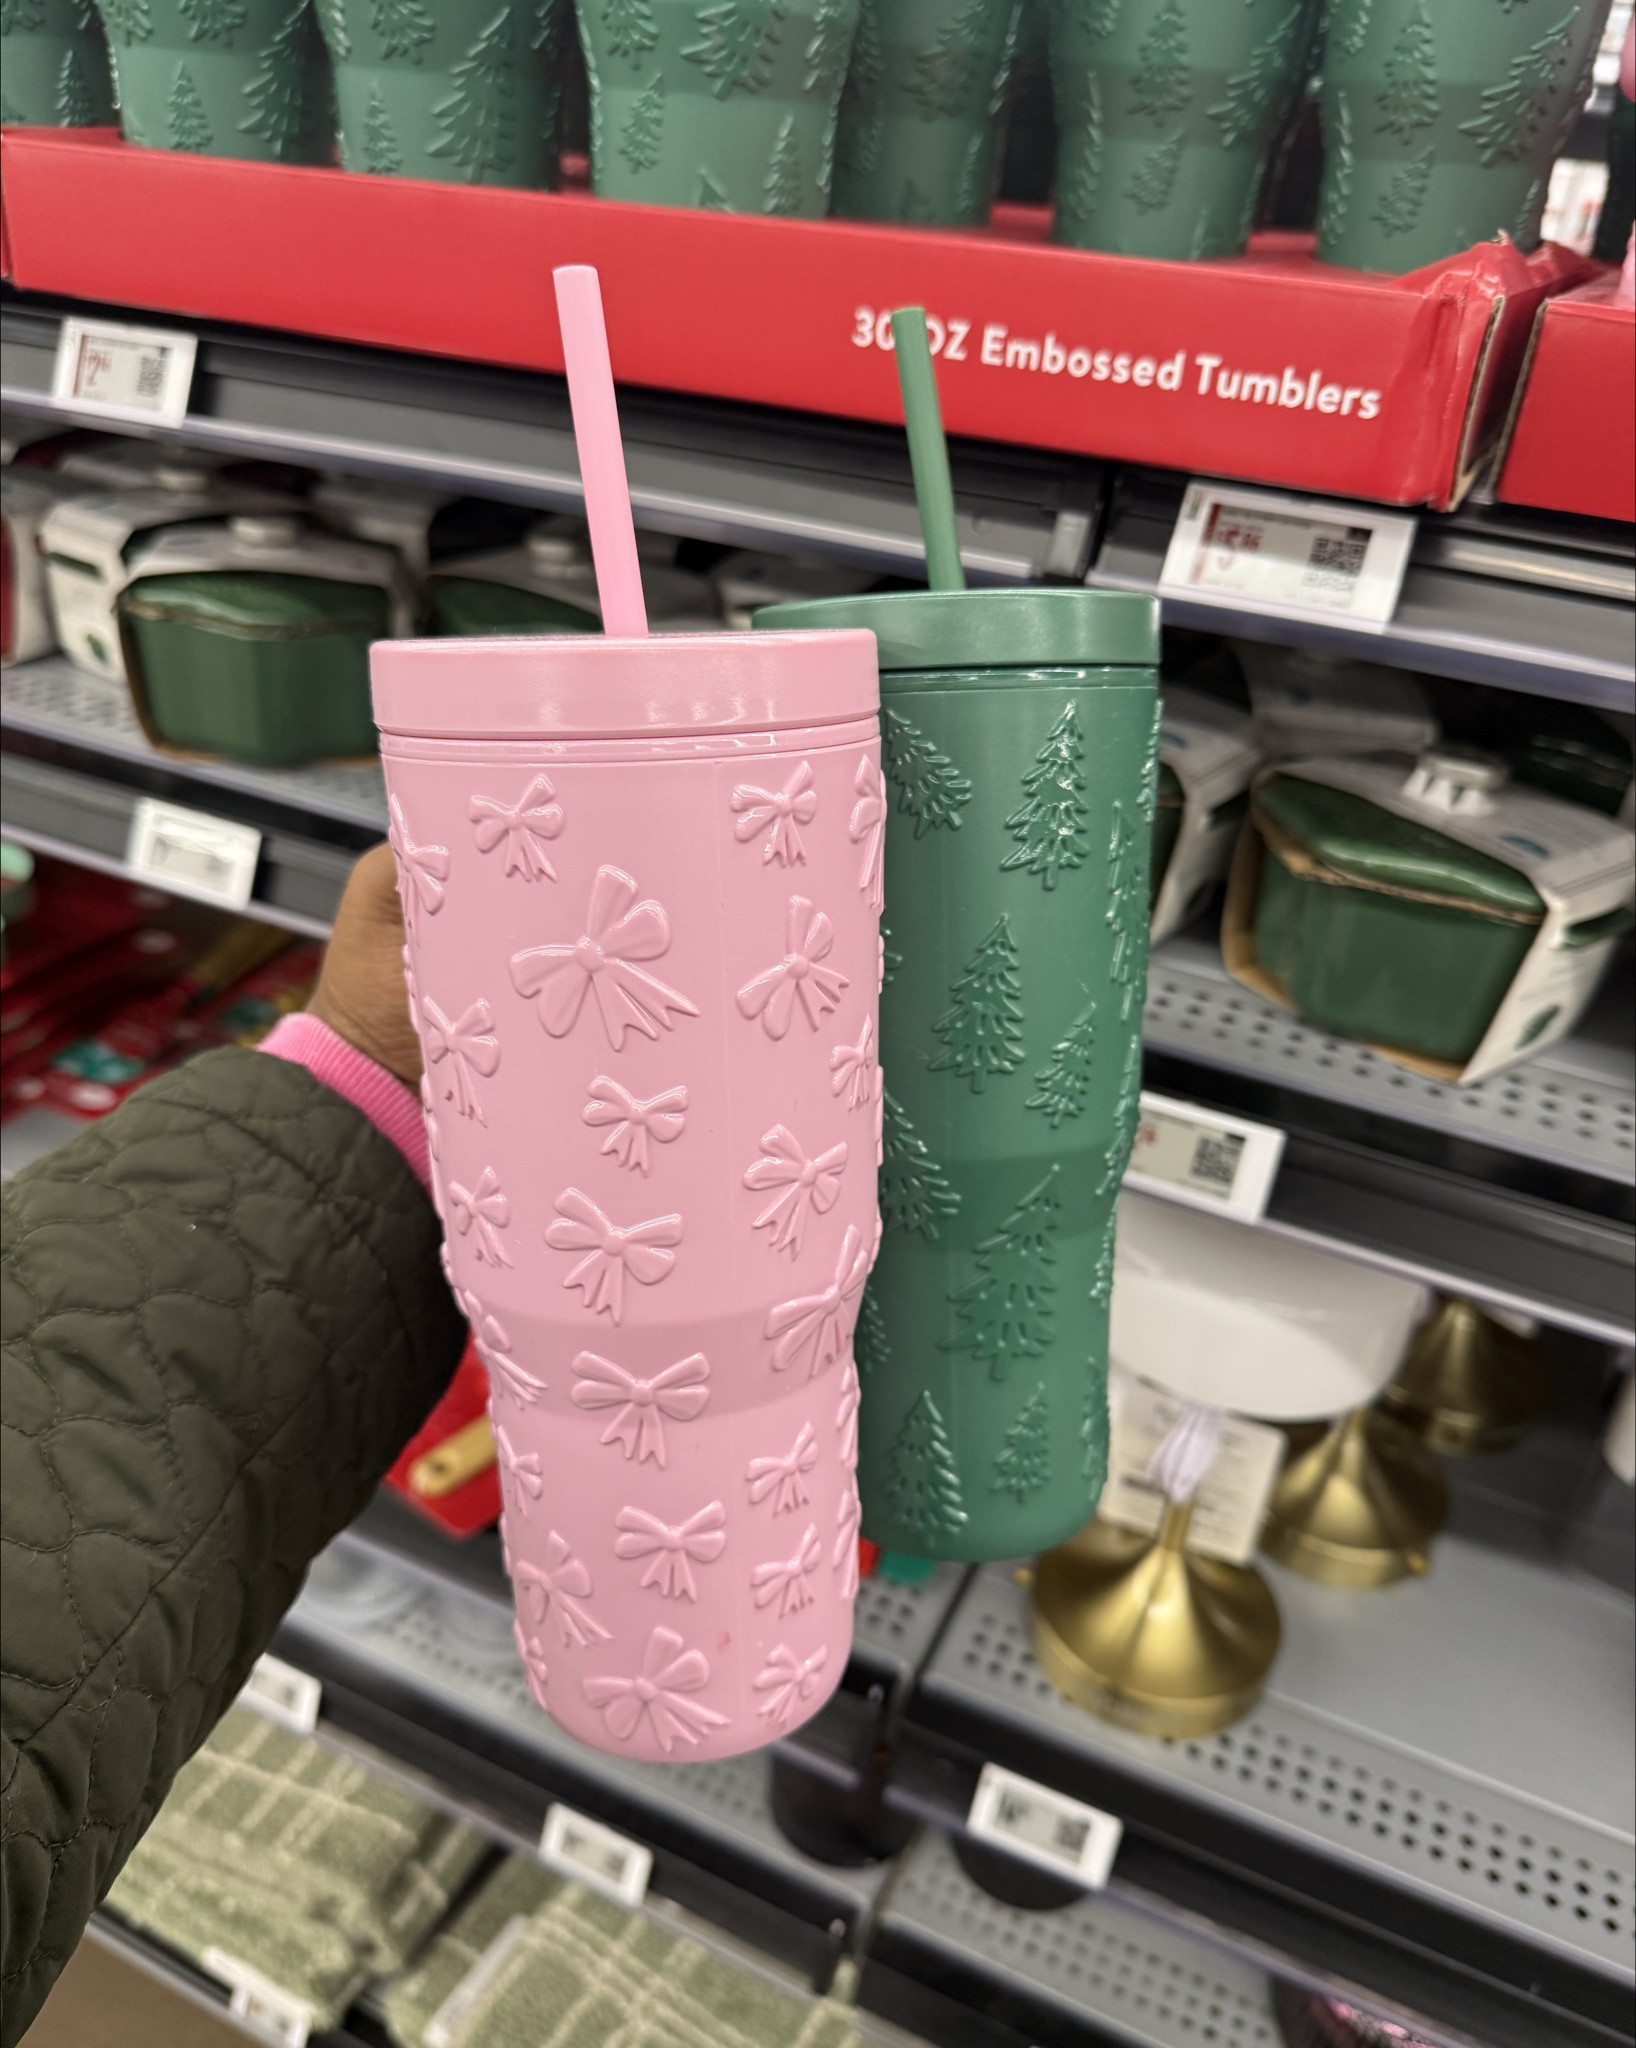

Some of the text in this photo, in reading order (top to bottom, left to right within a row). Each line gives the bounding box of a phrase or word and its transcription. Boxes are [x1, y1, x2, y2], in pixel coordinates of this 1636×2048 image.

[852, 306, 896, 351] 30
[980, 323, 1186, 391] Embossed
[1195, 353, 1381, 420] Tumblers
